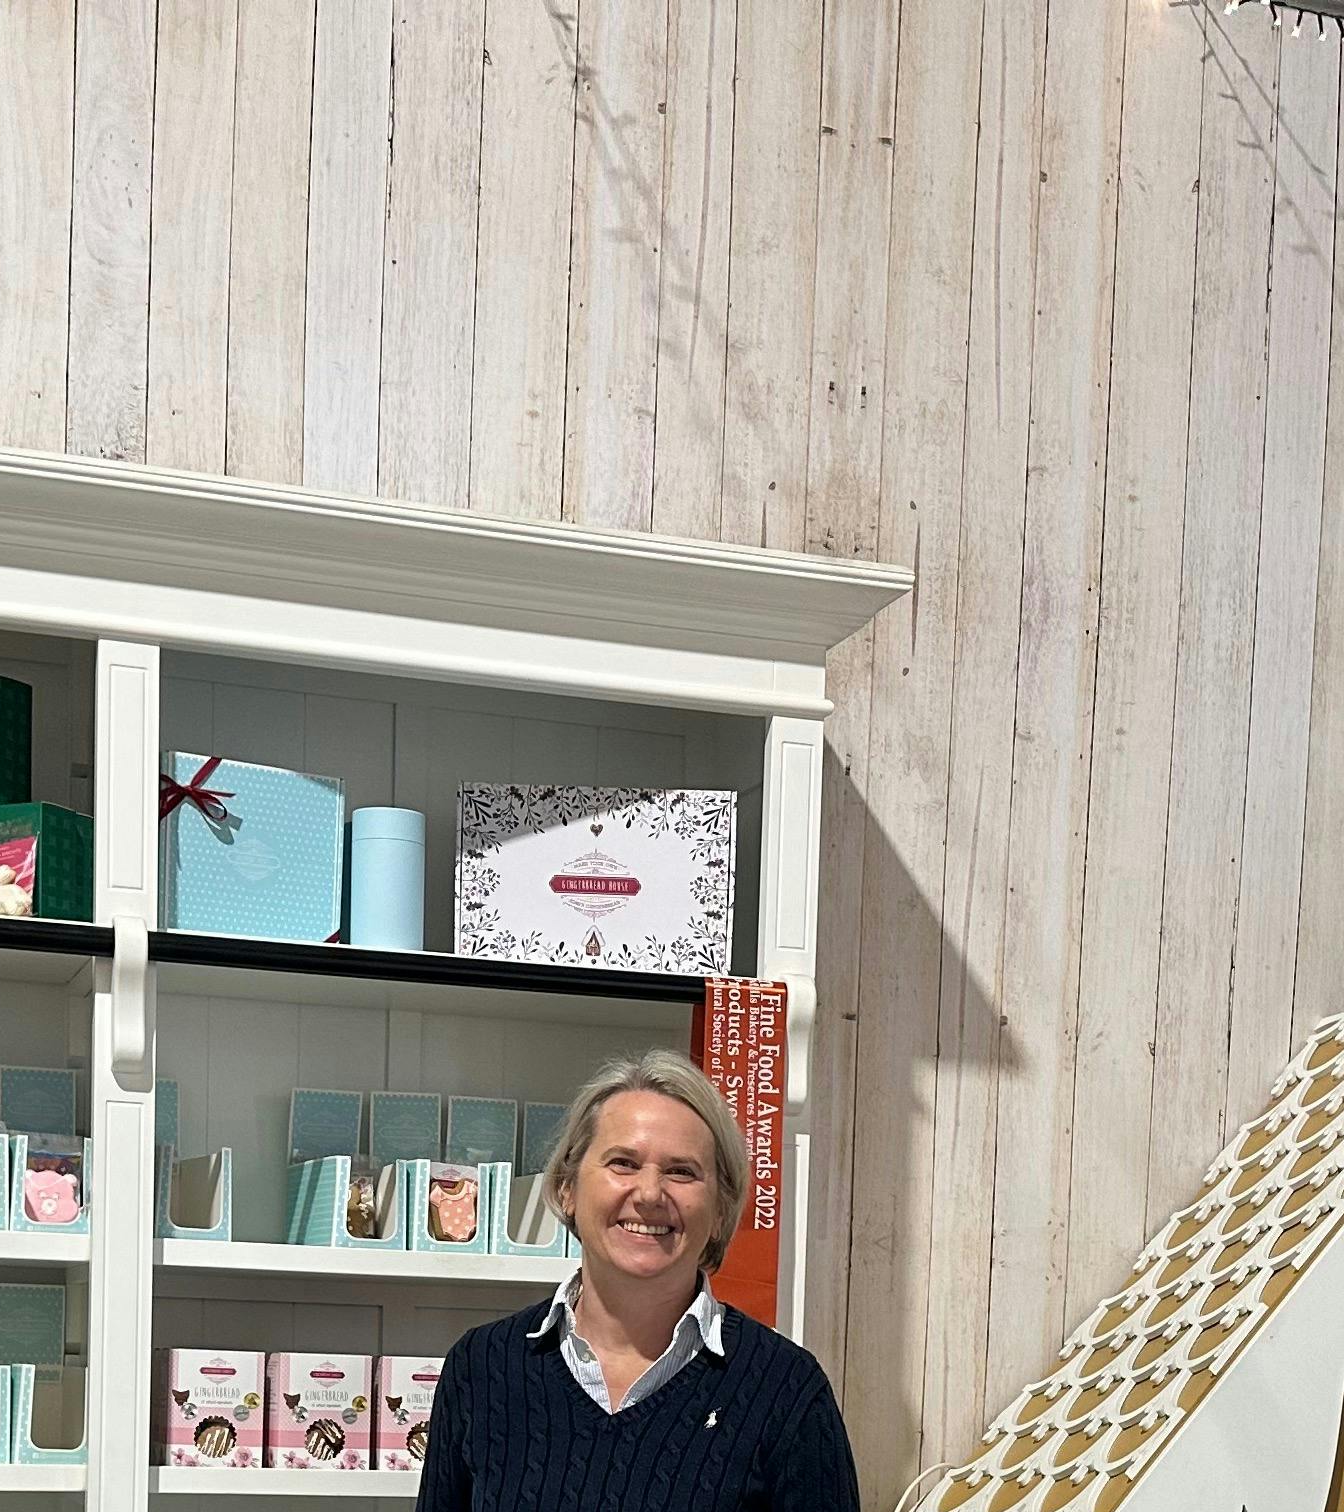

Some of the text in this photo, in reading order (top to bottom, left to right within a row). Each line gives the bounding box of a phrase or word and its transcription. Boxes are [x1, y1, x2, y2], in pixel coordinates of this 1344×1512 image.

[560, 879, 629, 892] GINGERBREAD HOUSE
[708, 1013, 726, 1056] Society
[745, 1006, 760, 1046] Bakery
[760, 993, 782, 1038] Fine
[711, 1057, 725, 1071] of
[748, 1048, 758, 1060] &
[758, 1043, 780, 1095] Food
[746, 1062, 759, 1116] Preserves
[756, 1099, 779, 1180] Awards
[754, 1184, 777, 1230] 2022
[194, 1386, 241, 1399] GINGERBREAD
[304, 1389, 349, 1402] GINGERBREAD
